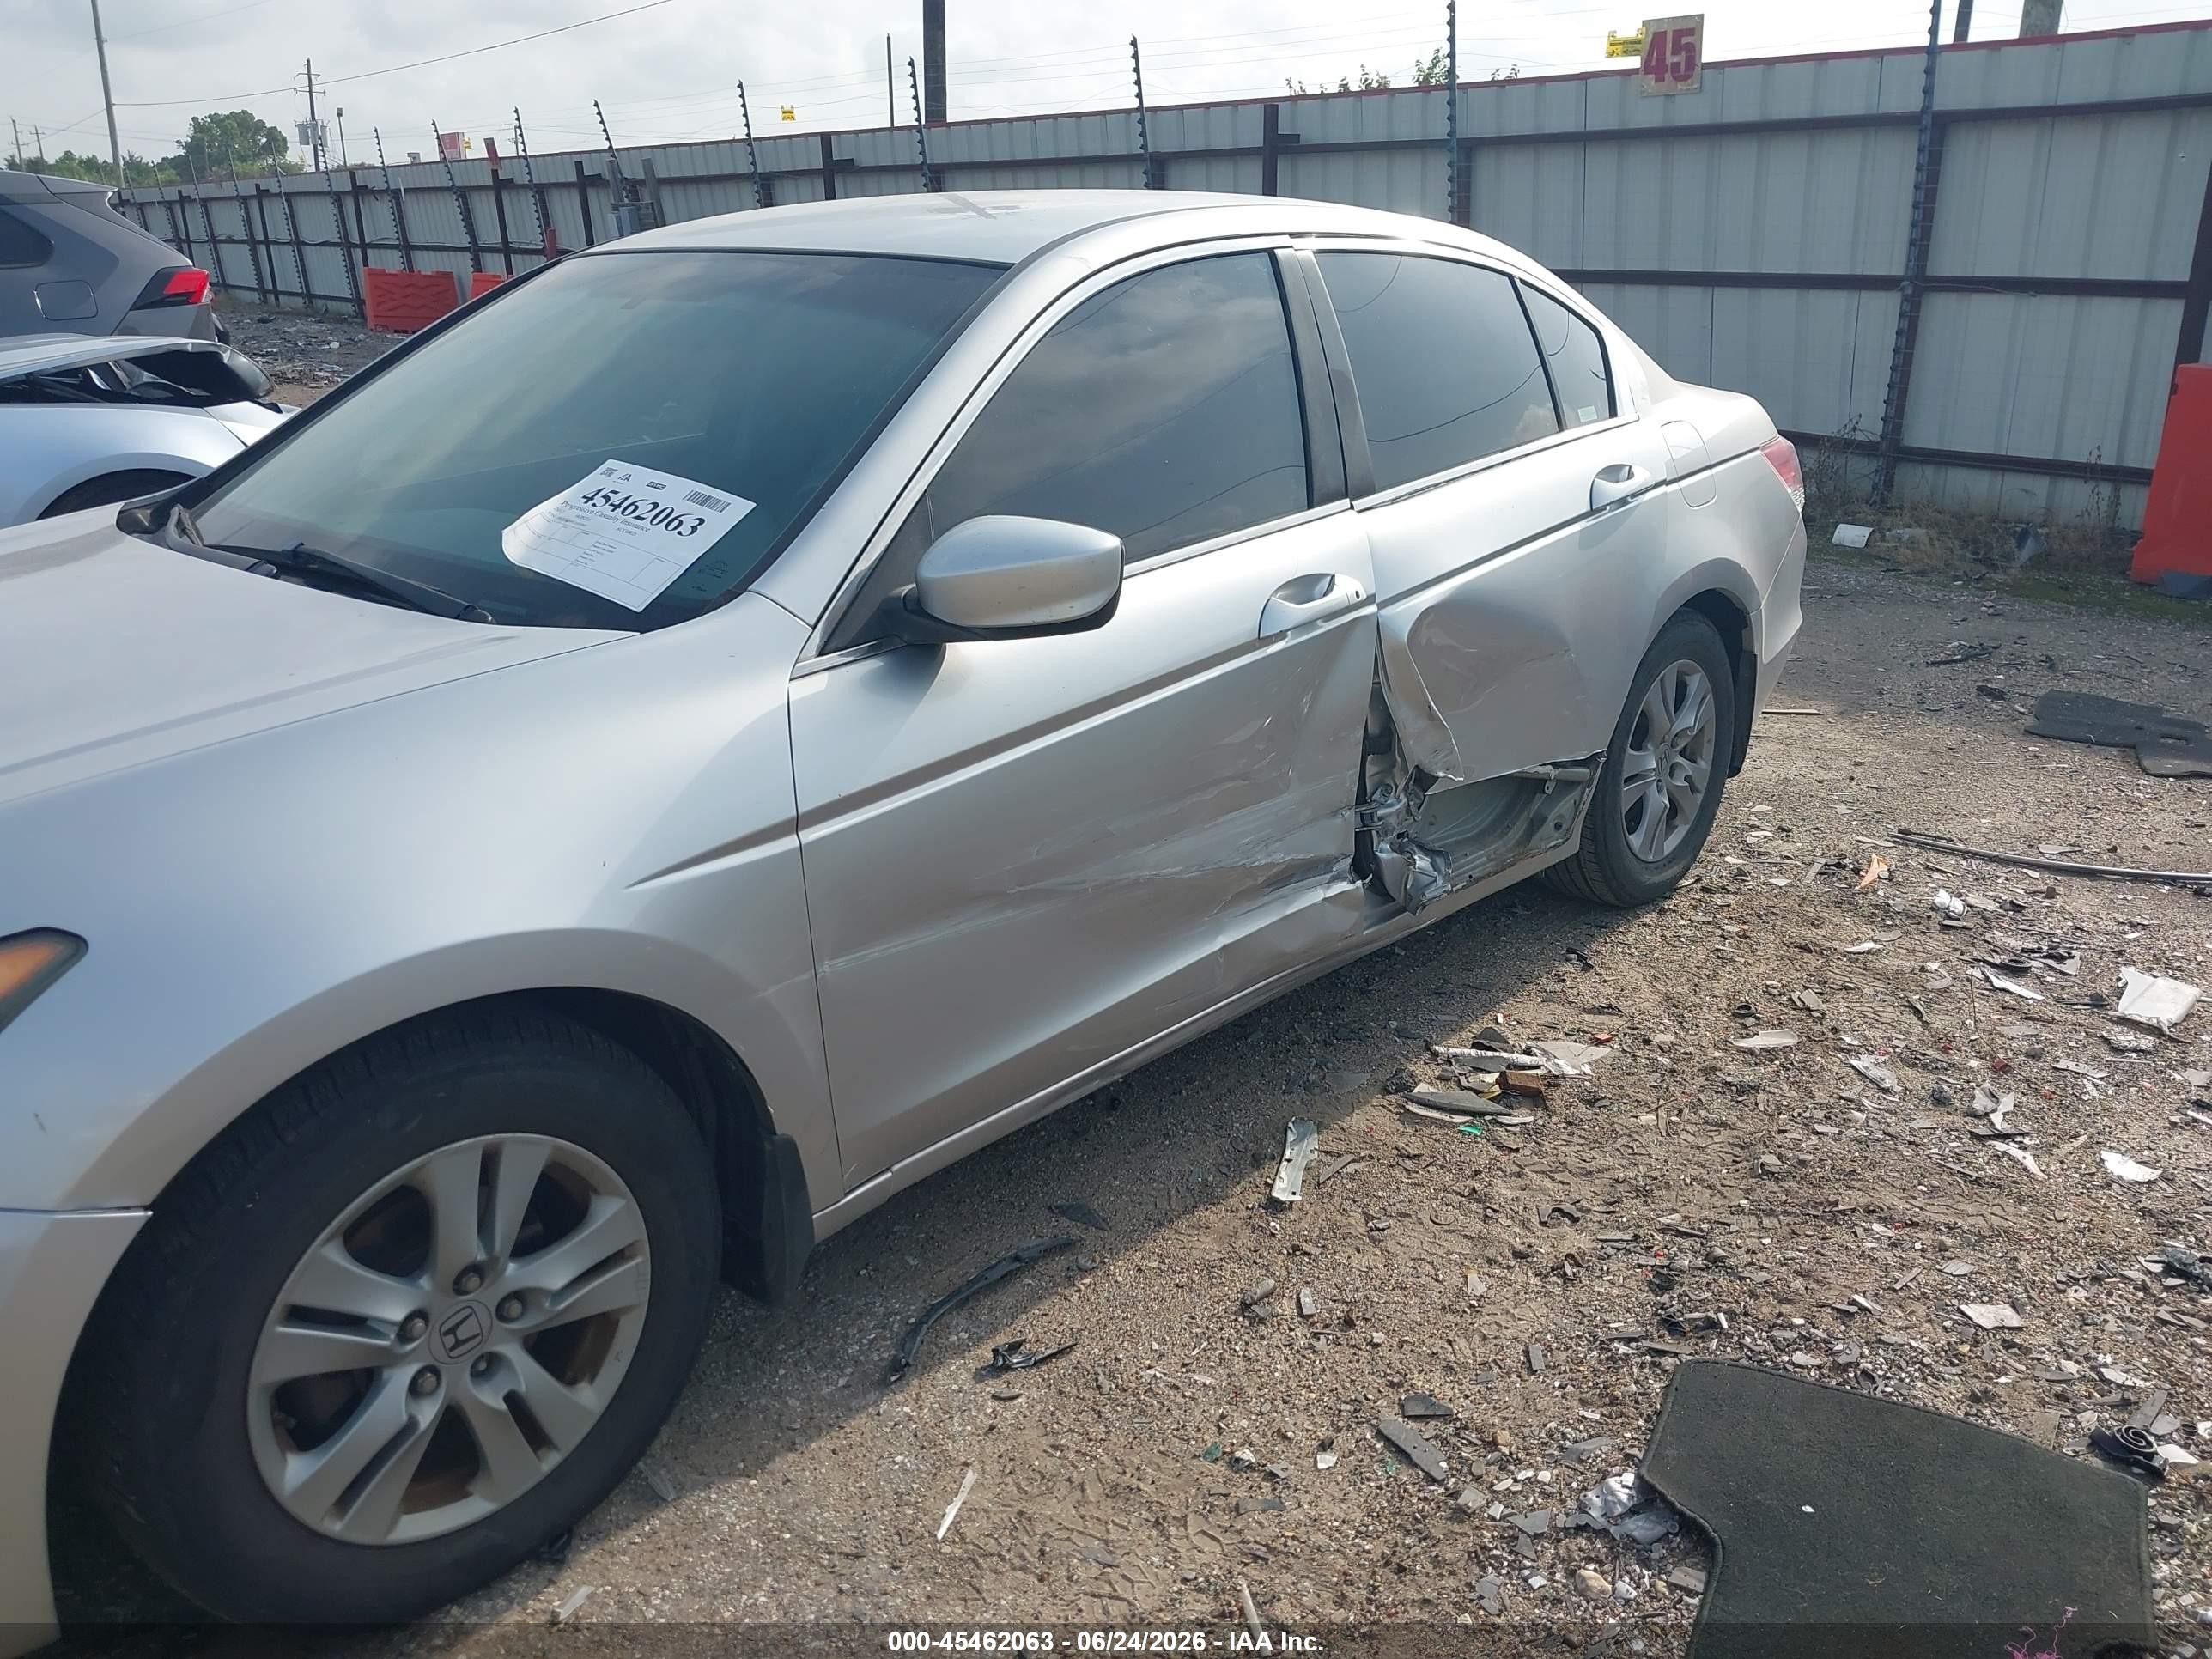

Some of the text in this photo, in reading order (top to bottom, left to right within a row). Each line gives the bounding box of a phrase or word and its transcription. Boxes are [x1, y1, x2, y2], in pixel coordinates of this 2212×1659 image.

[1644, 27, 1697, 83] 45
[561, 501, 595, 515] Progressive
[594, 510, 620, 524] Casualty
[619, 517, 652, 532] Insurance
[581, 487, 705, 537] 45462063
